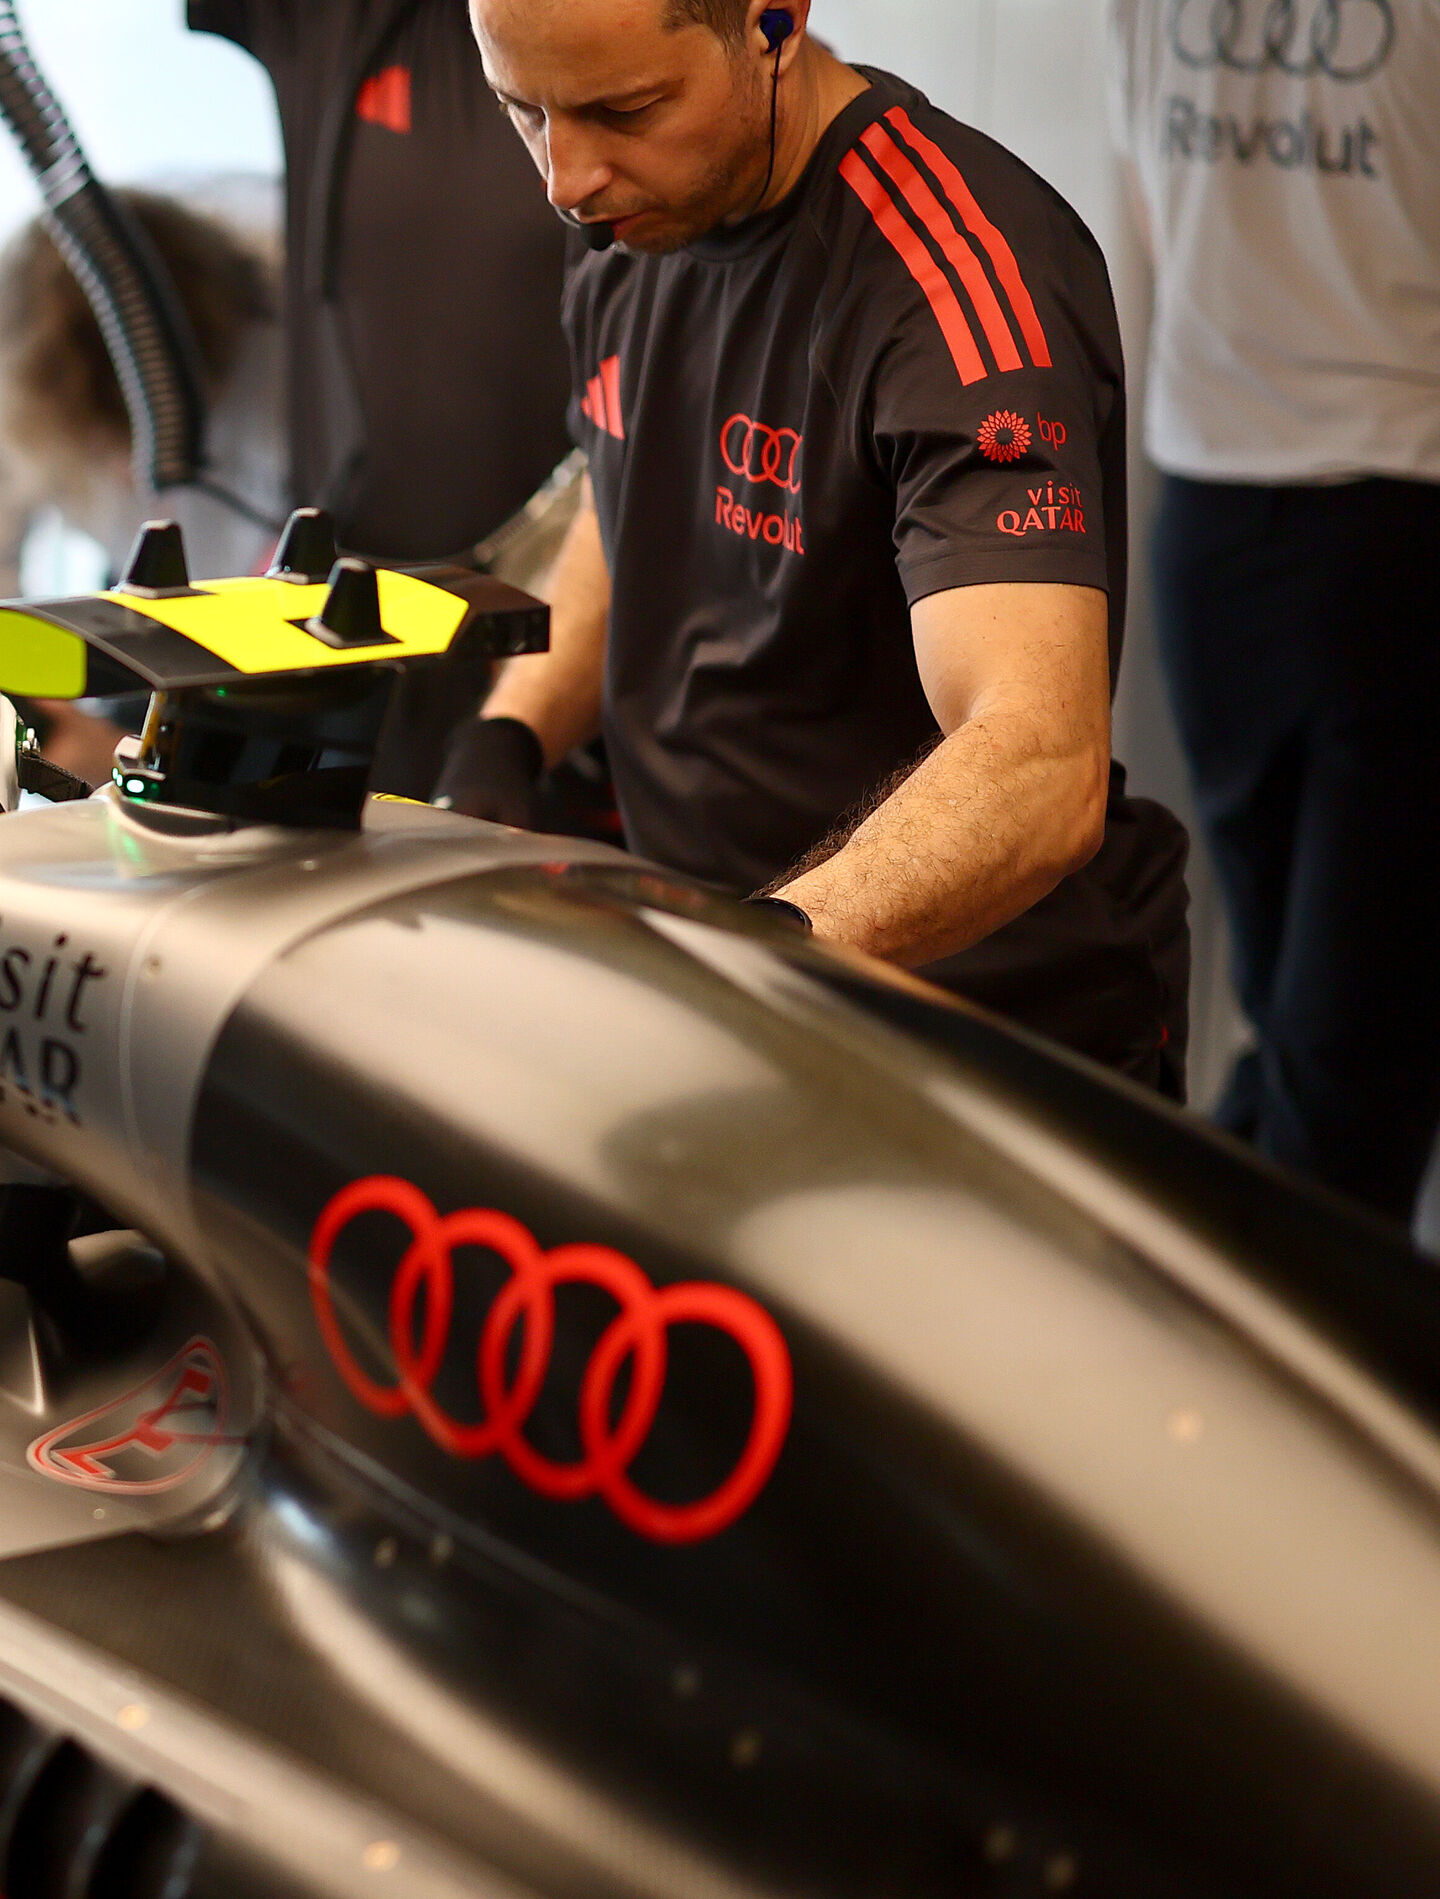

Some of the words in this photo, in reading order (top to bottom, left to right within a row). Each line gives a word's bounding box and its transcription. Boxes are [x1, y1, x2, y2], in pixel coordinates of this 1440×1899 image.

[1165, 95, 1378, 179] Revolut
[1036, 411, 1067, 451] bp
[1027, 480, 1084, 508] visit
[715, 485, 805, 555] Revolut
[996, 506, 1087, 536] QATAR
